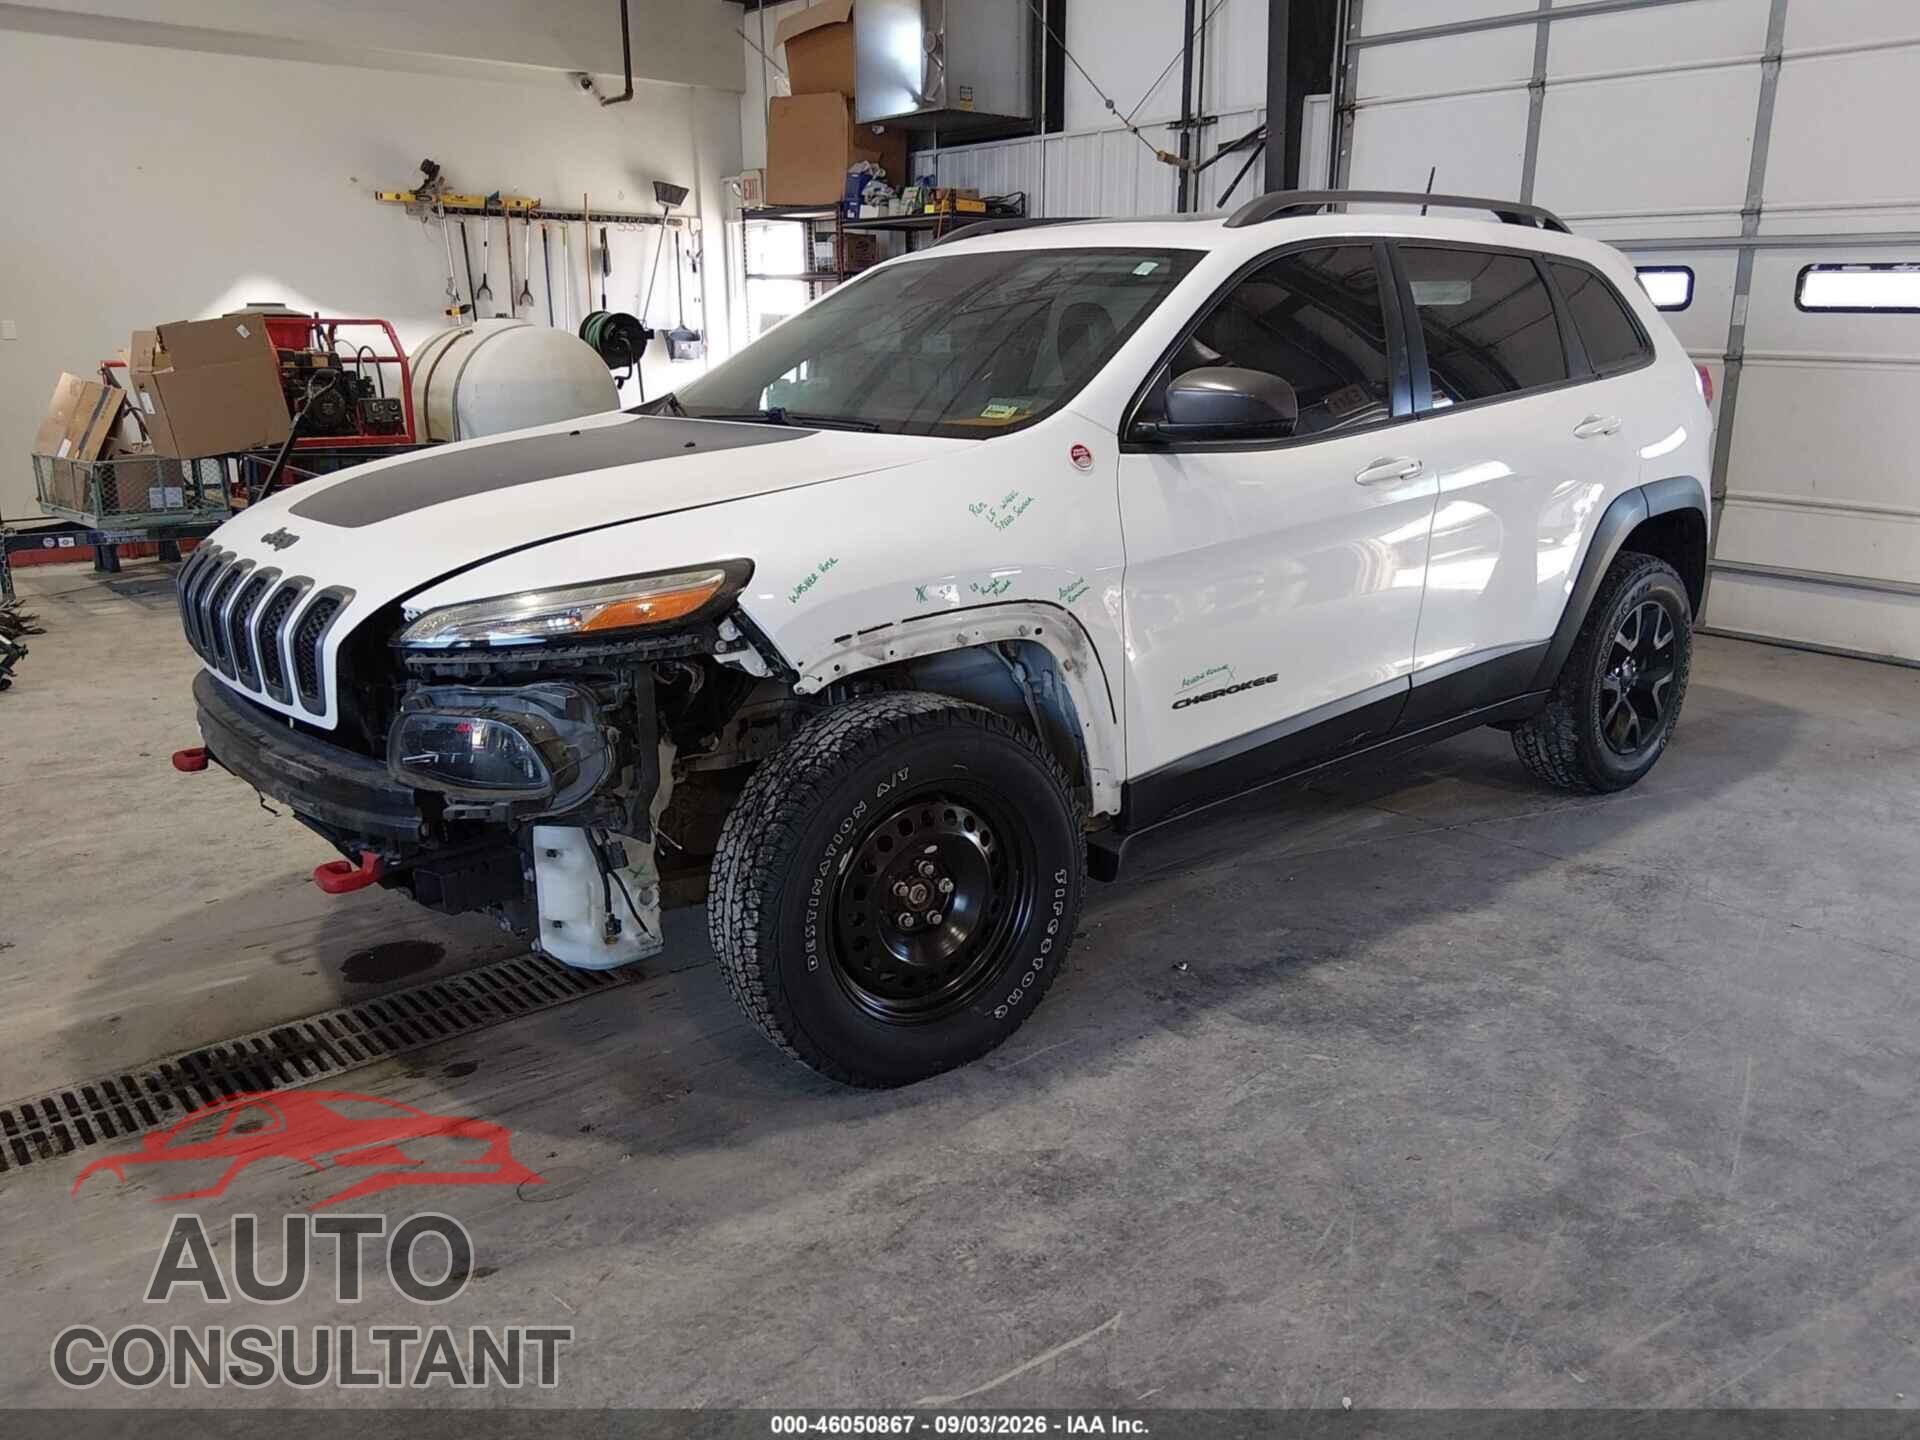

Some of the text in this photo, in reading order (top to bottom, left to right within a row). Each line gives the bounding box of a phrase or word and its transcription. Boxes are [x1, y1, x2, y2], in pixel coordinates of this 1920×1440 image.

[1172, 673, 1279, 710] CHEROKEE
[804, 766, 911, 971] DESTINATION A/T
